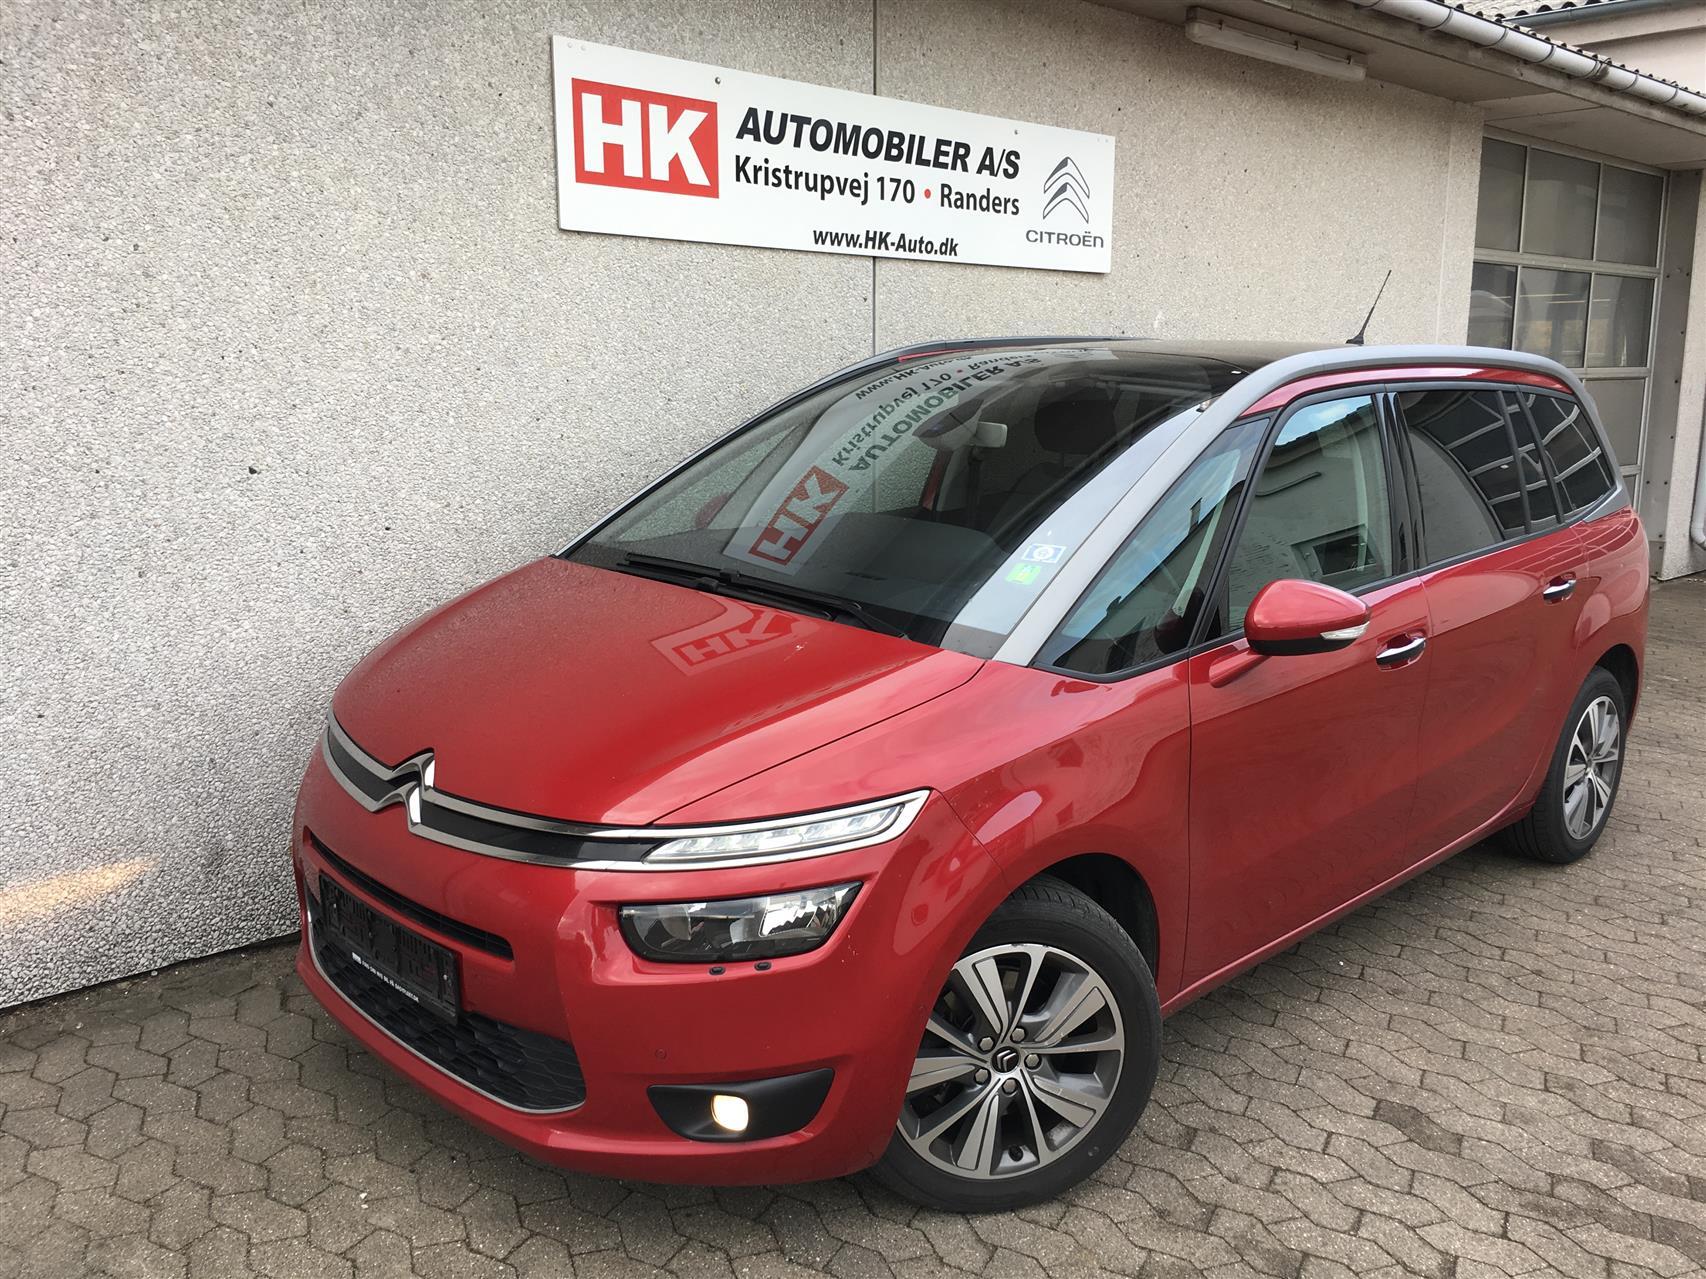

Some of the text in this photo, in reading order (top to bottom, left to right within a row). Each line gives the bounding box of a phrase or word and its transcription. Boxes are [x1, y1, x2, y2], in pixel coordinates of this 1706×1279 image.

[581, 92, 711, 187] HK
[735, 106, 1021, 179] AUTOMOBILER A/S
[734, 154, 1020, 216] Kristrupvej 170 Randers
[813, 230, 959, 257] www.HK-Auto.dk
